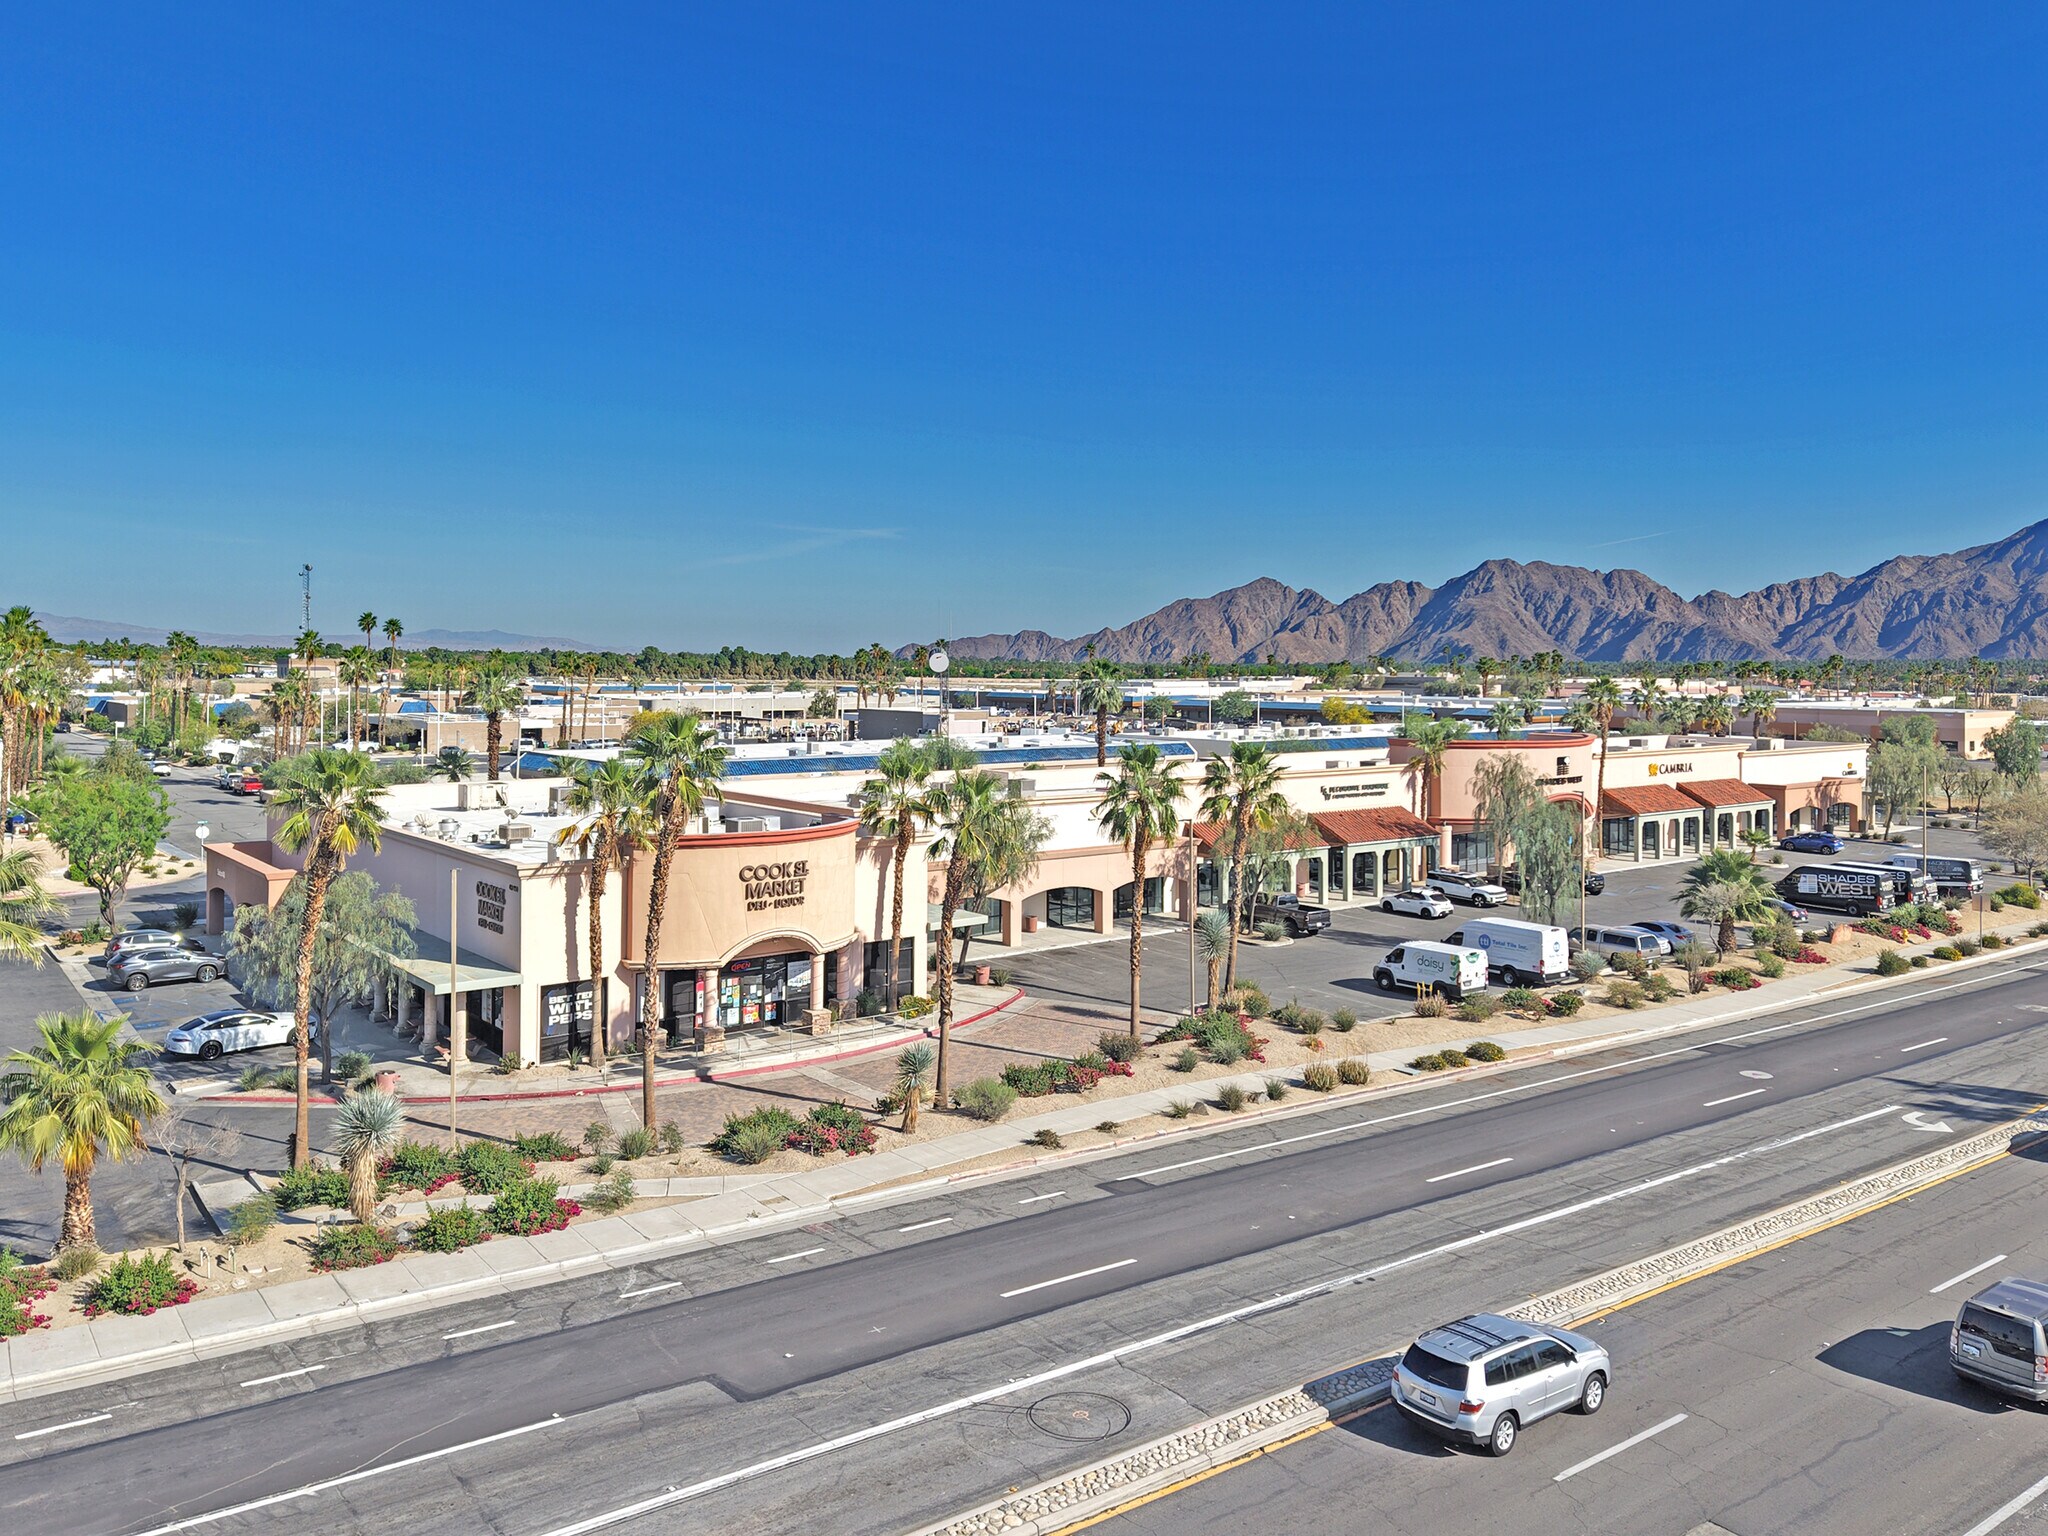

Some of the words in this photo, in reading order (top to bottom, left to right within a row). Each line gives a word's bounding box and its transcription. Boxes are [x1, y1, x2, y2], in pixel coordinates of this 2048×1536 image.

[1659, 763, 1692, 774] CAMBRIA
[739, 862, 792, 882] COOK
[1818, 874, 1876, 884] SHADES
[745, 878, 806, 900] MARKET
[1819, 882, 1876, 896] WEST
[478, 899, 505, 922] MARKET
[747, 900, 767, 912] DELI
[774, 896, 805, 909] LIQUOR
[731, 962, 751, 971] OPEN
[1417, 955, 1444, 972] daisy
